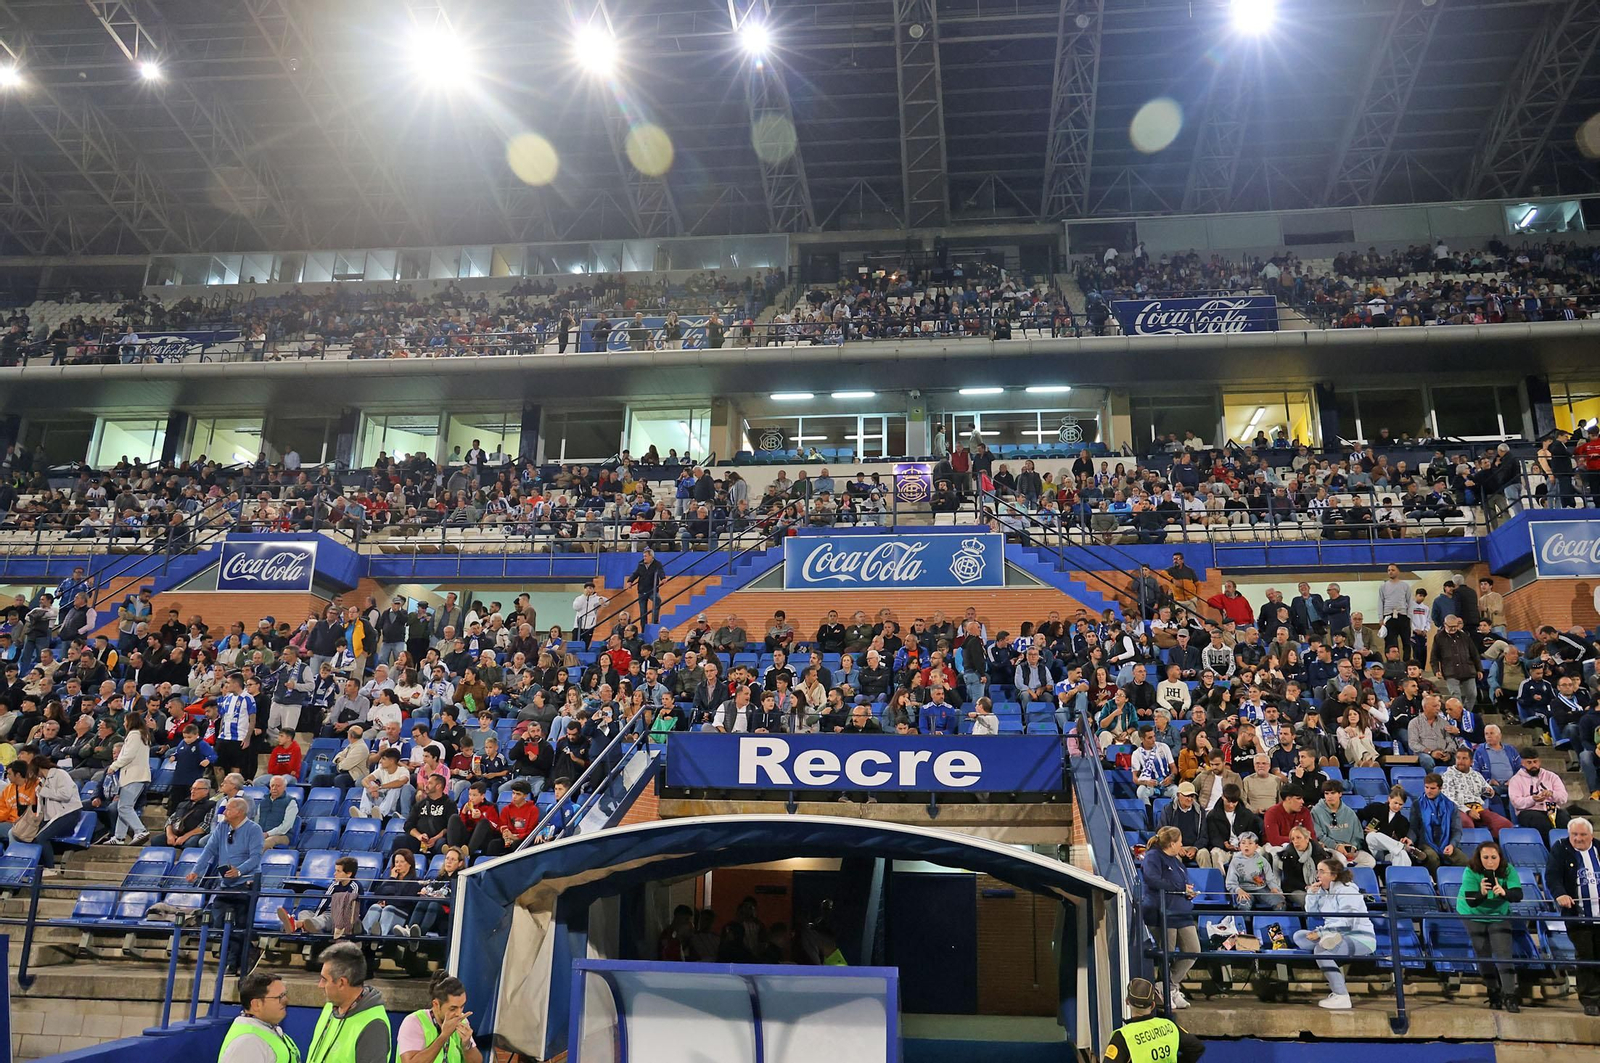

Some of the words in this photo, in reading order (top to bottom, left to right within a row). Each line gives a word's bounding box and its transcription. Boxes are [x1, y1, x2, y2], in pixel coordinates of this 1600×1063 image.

[223, 552, 310, 582] Coca-Cola
[802, 541, 930, 582] Coca-Cola
[738, 737, 982, 787] Recre
[1134, 1023, 1174, 1045] SEGURIDAD
[1151, 1044, 1171, 1061] 039
